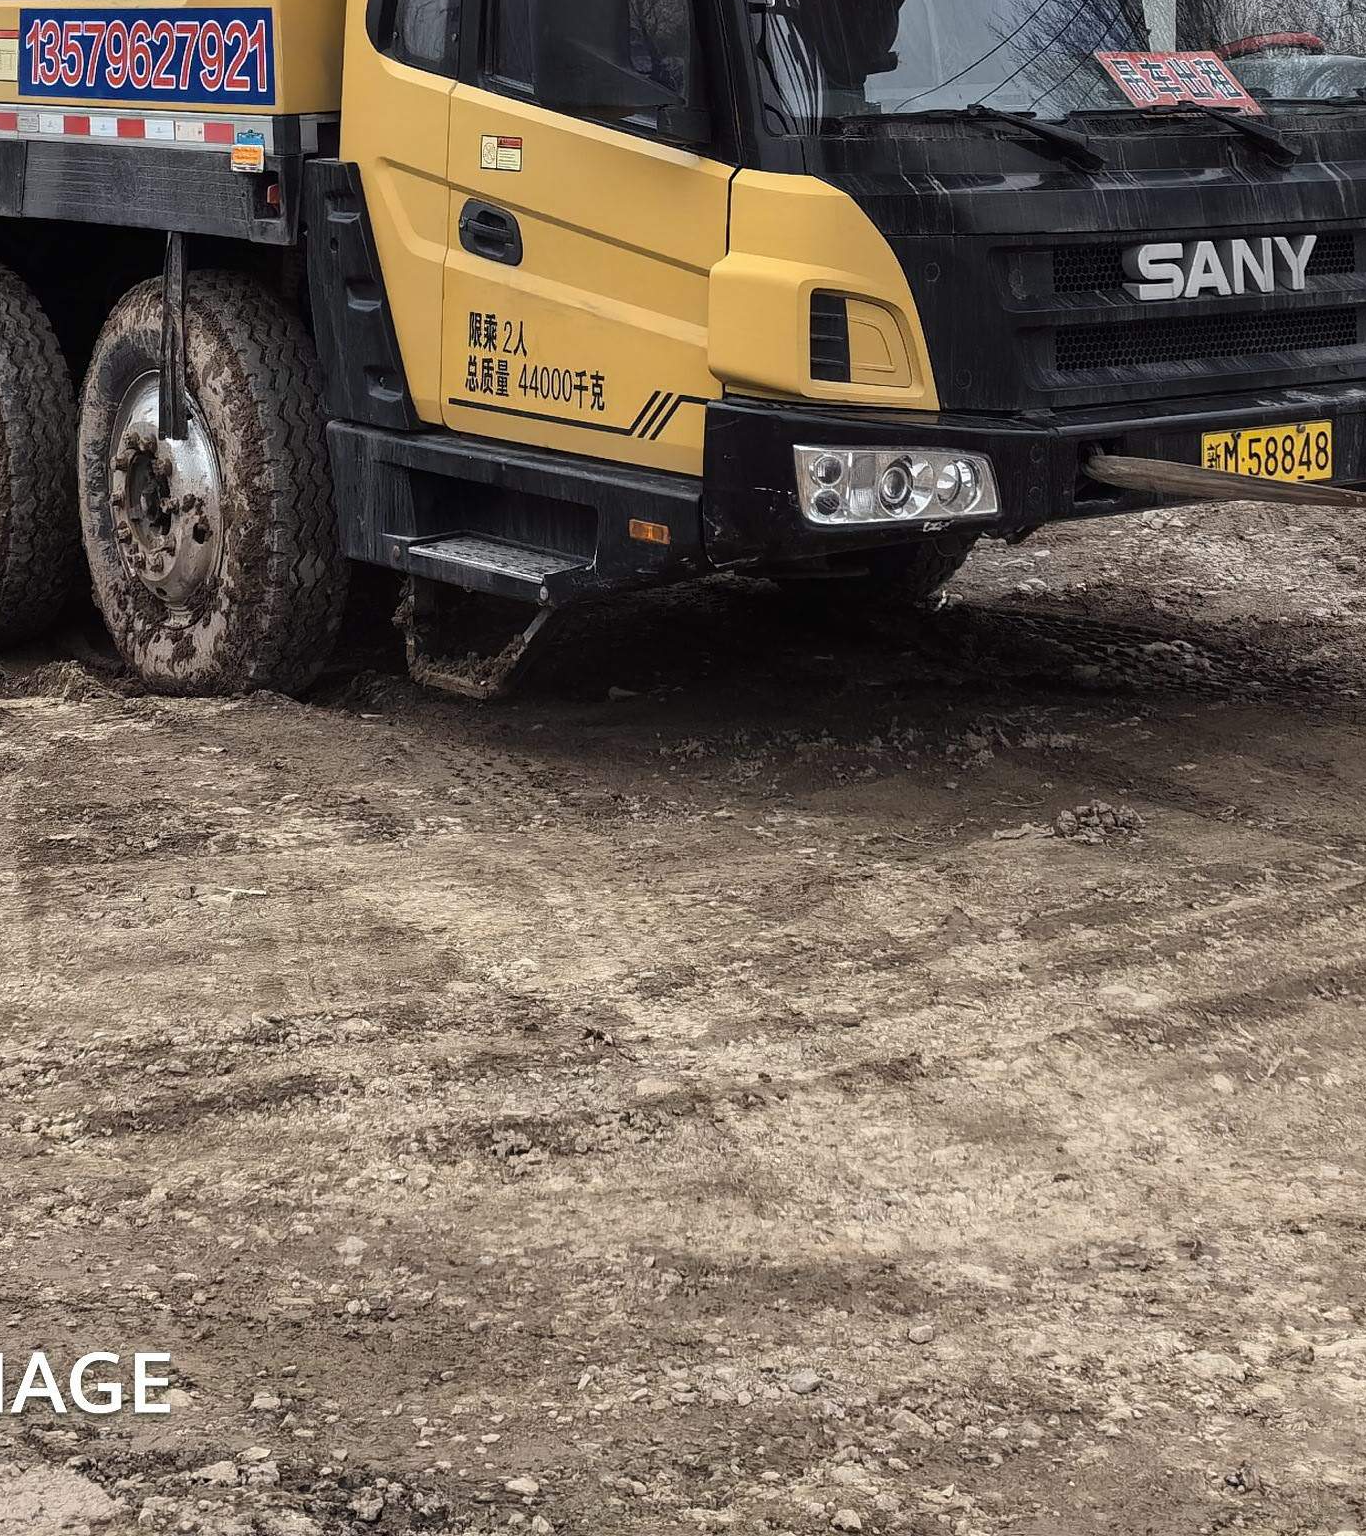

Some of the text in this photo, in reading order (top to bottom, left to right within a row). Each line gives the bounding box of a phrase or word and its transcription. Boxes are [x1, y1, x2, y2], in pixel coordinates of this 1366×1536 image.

[26, 18, 267, 92] 13579627921
[1109, 58, 1246, 102] 吊车出租
[1137, 234, 1317, 301] SANY
[468, 311, 528, 358] 限乘 2人
[465, 355, 606, 411] 总质量 44000千克
